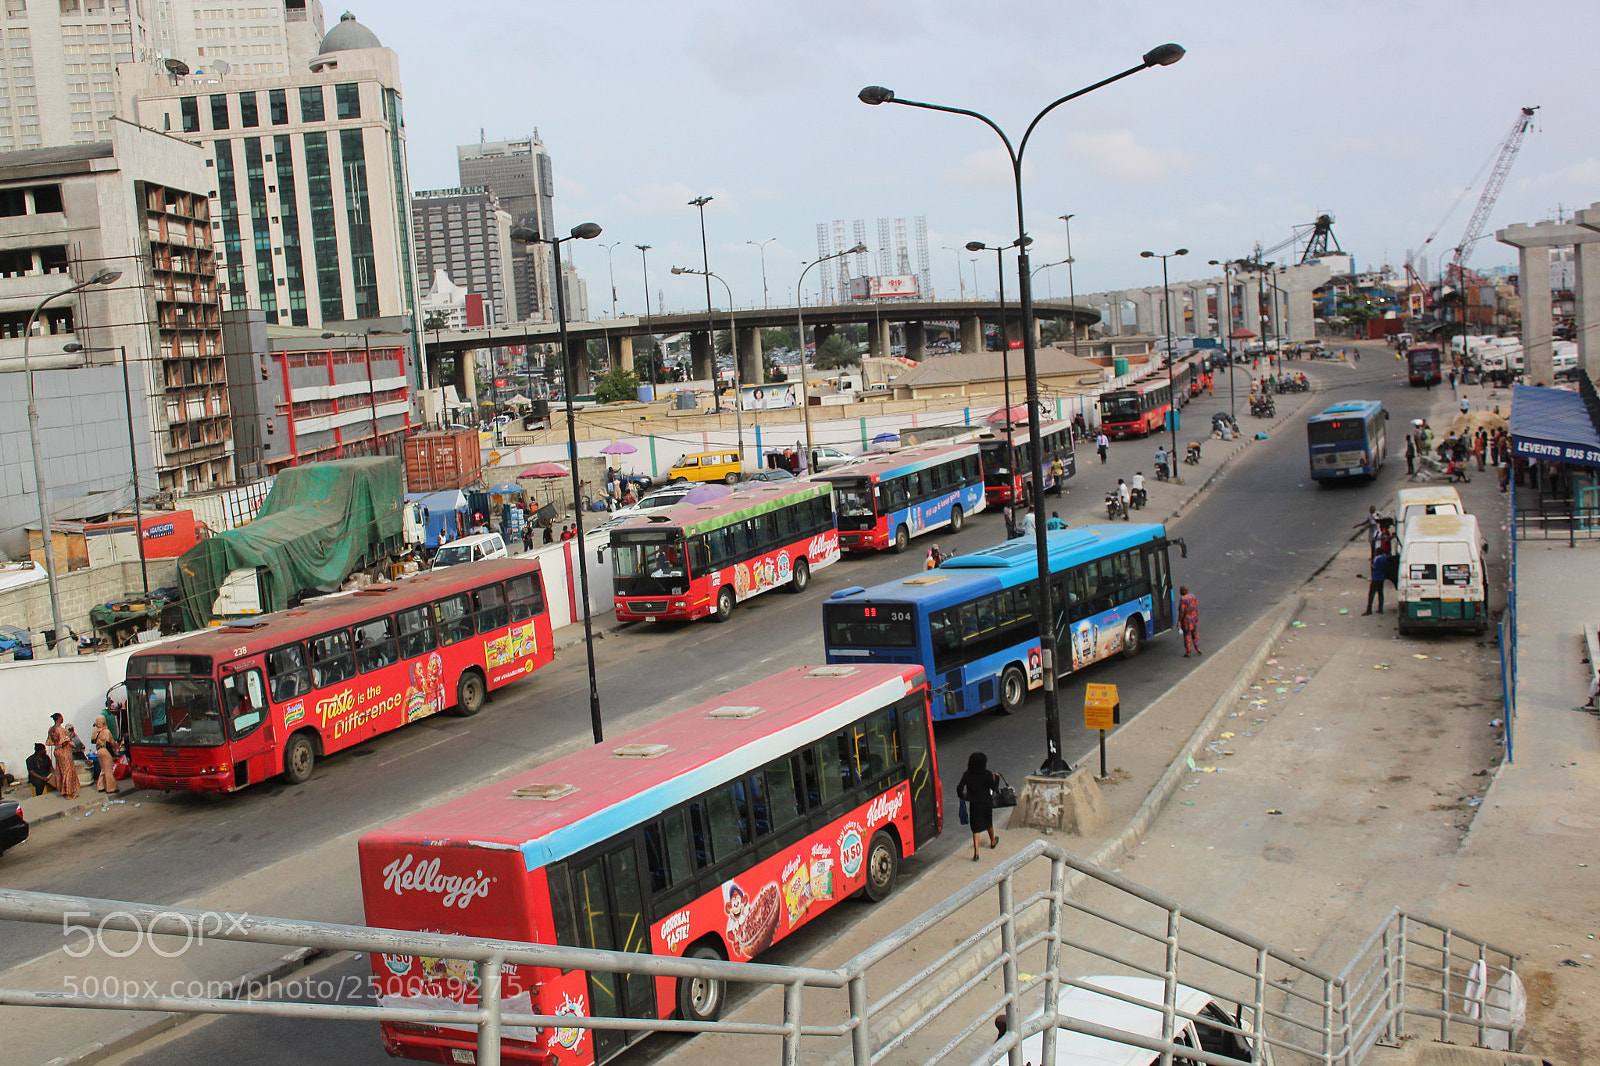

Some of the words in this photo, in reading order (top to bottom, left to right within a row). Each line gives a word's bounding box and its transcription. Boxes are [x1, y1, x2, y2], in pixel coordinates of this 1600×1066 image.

[1517, 441, 1561, 456] LEVENTIS
[1565, 447, 1585, 459] BUS
[891, 612, 911, 621] 304
[233, 646, 248, 657] 238
[315, 688, 355, 729] Taste
[357, 692, 365, 705] is
[366, 685, 381, 700] the
[334, 693, 402, 740] Difference
[866, 791, 903, 828] Kellogg's
[382, 853, 491, 909] Kellogg's
